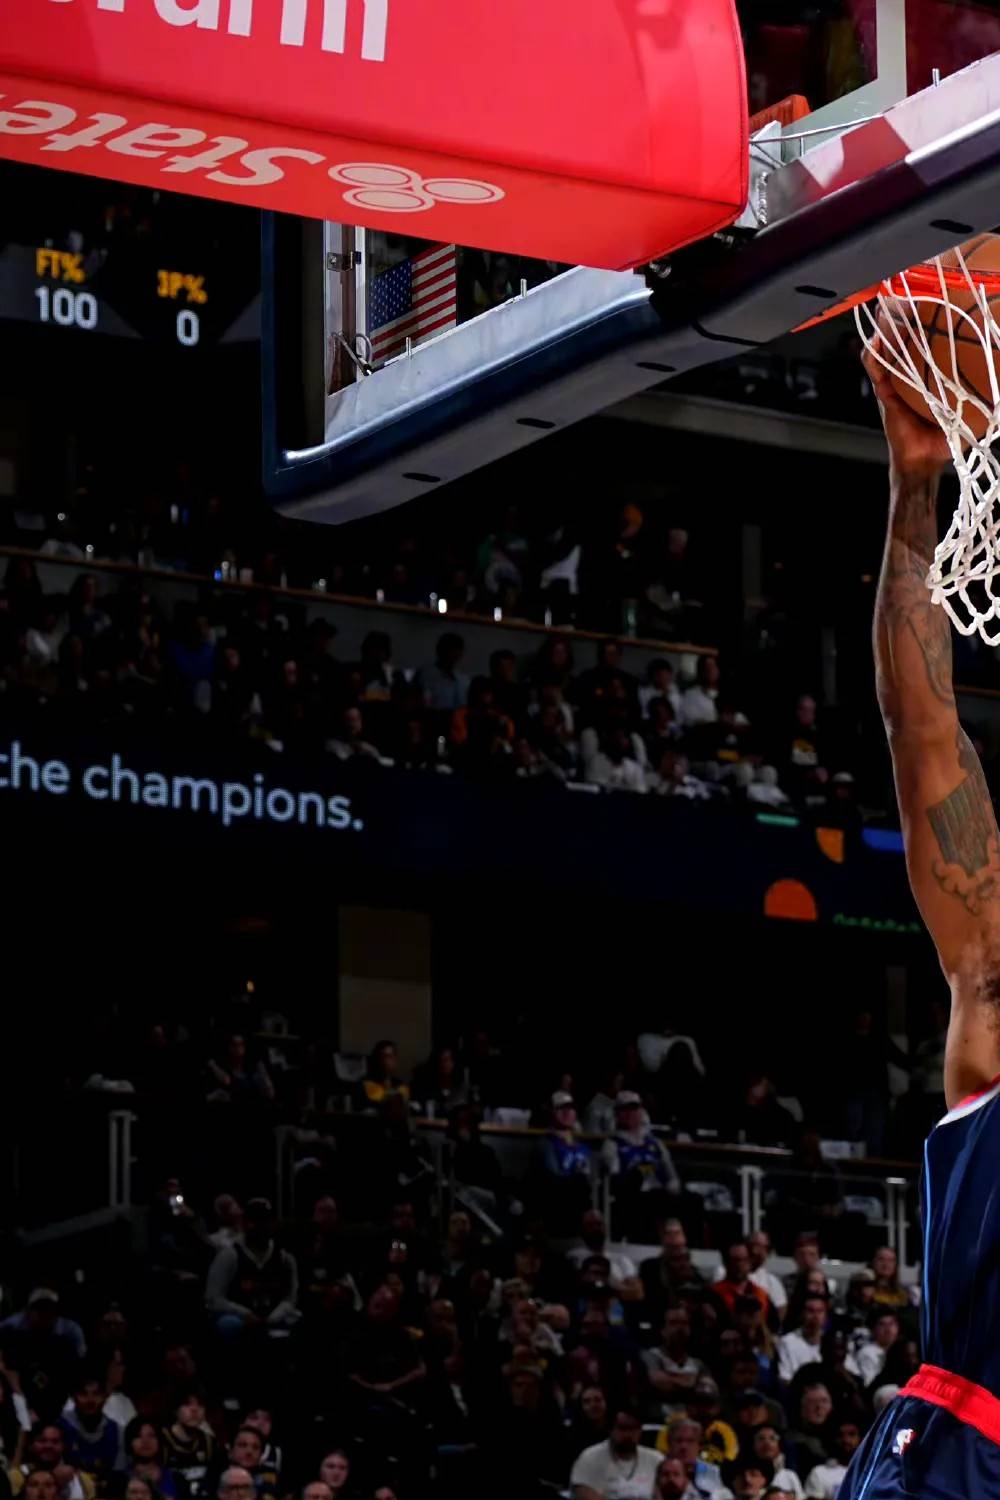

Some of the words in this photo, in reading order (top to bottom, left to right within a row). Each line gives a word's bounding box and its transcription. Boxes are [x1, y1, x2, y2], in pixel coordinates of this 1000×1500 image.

[35, 247, 86, 284] FT%
[34, 285, 98, 330] 100
[176, 309, 200, 347] 0
[83, 753, 364, 830] champions.
